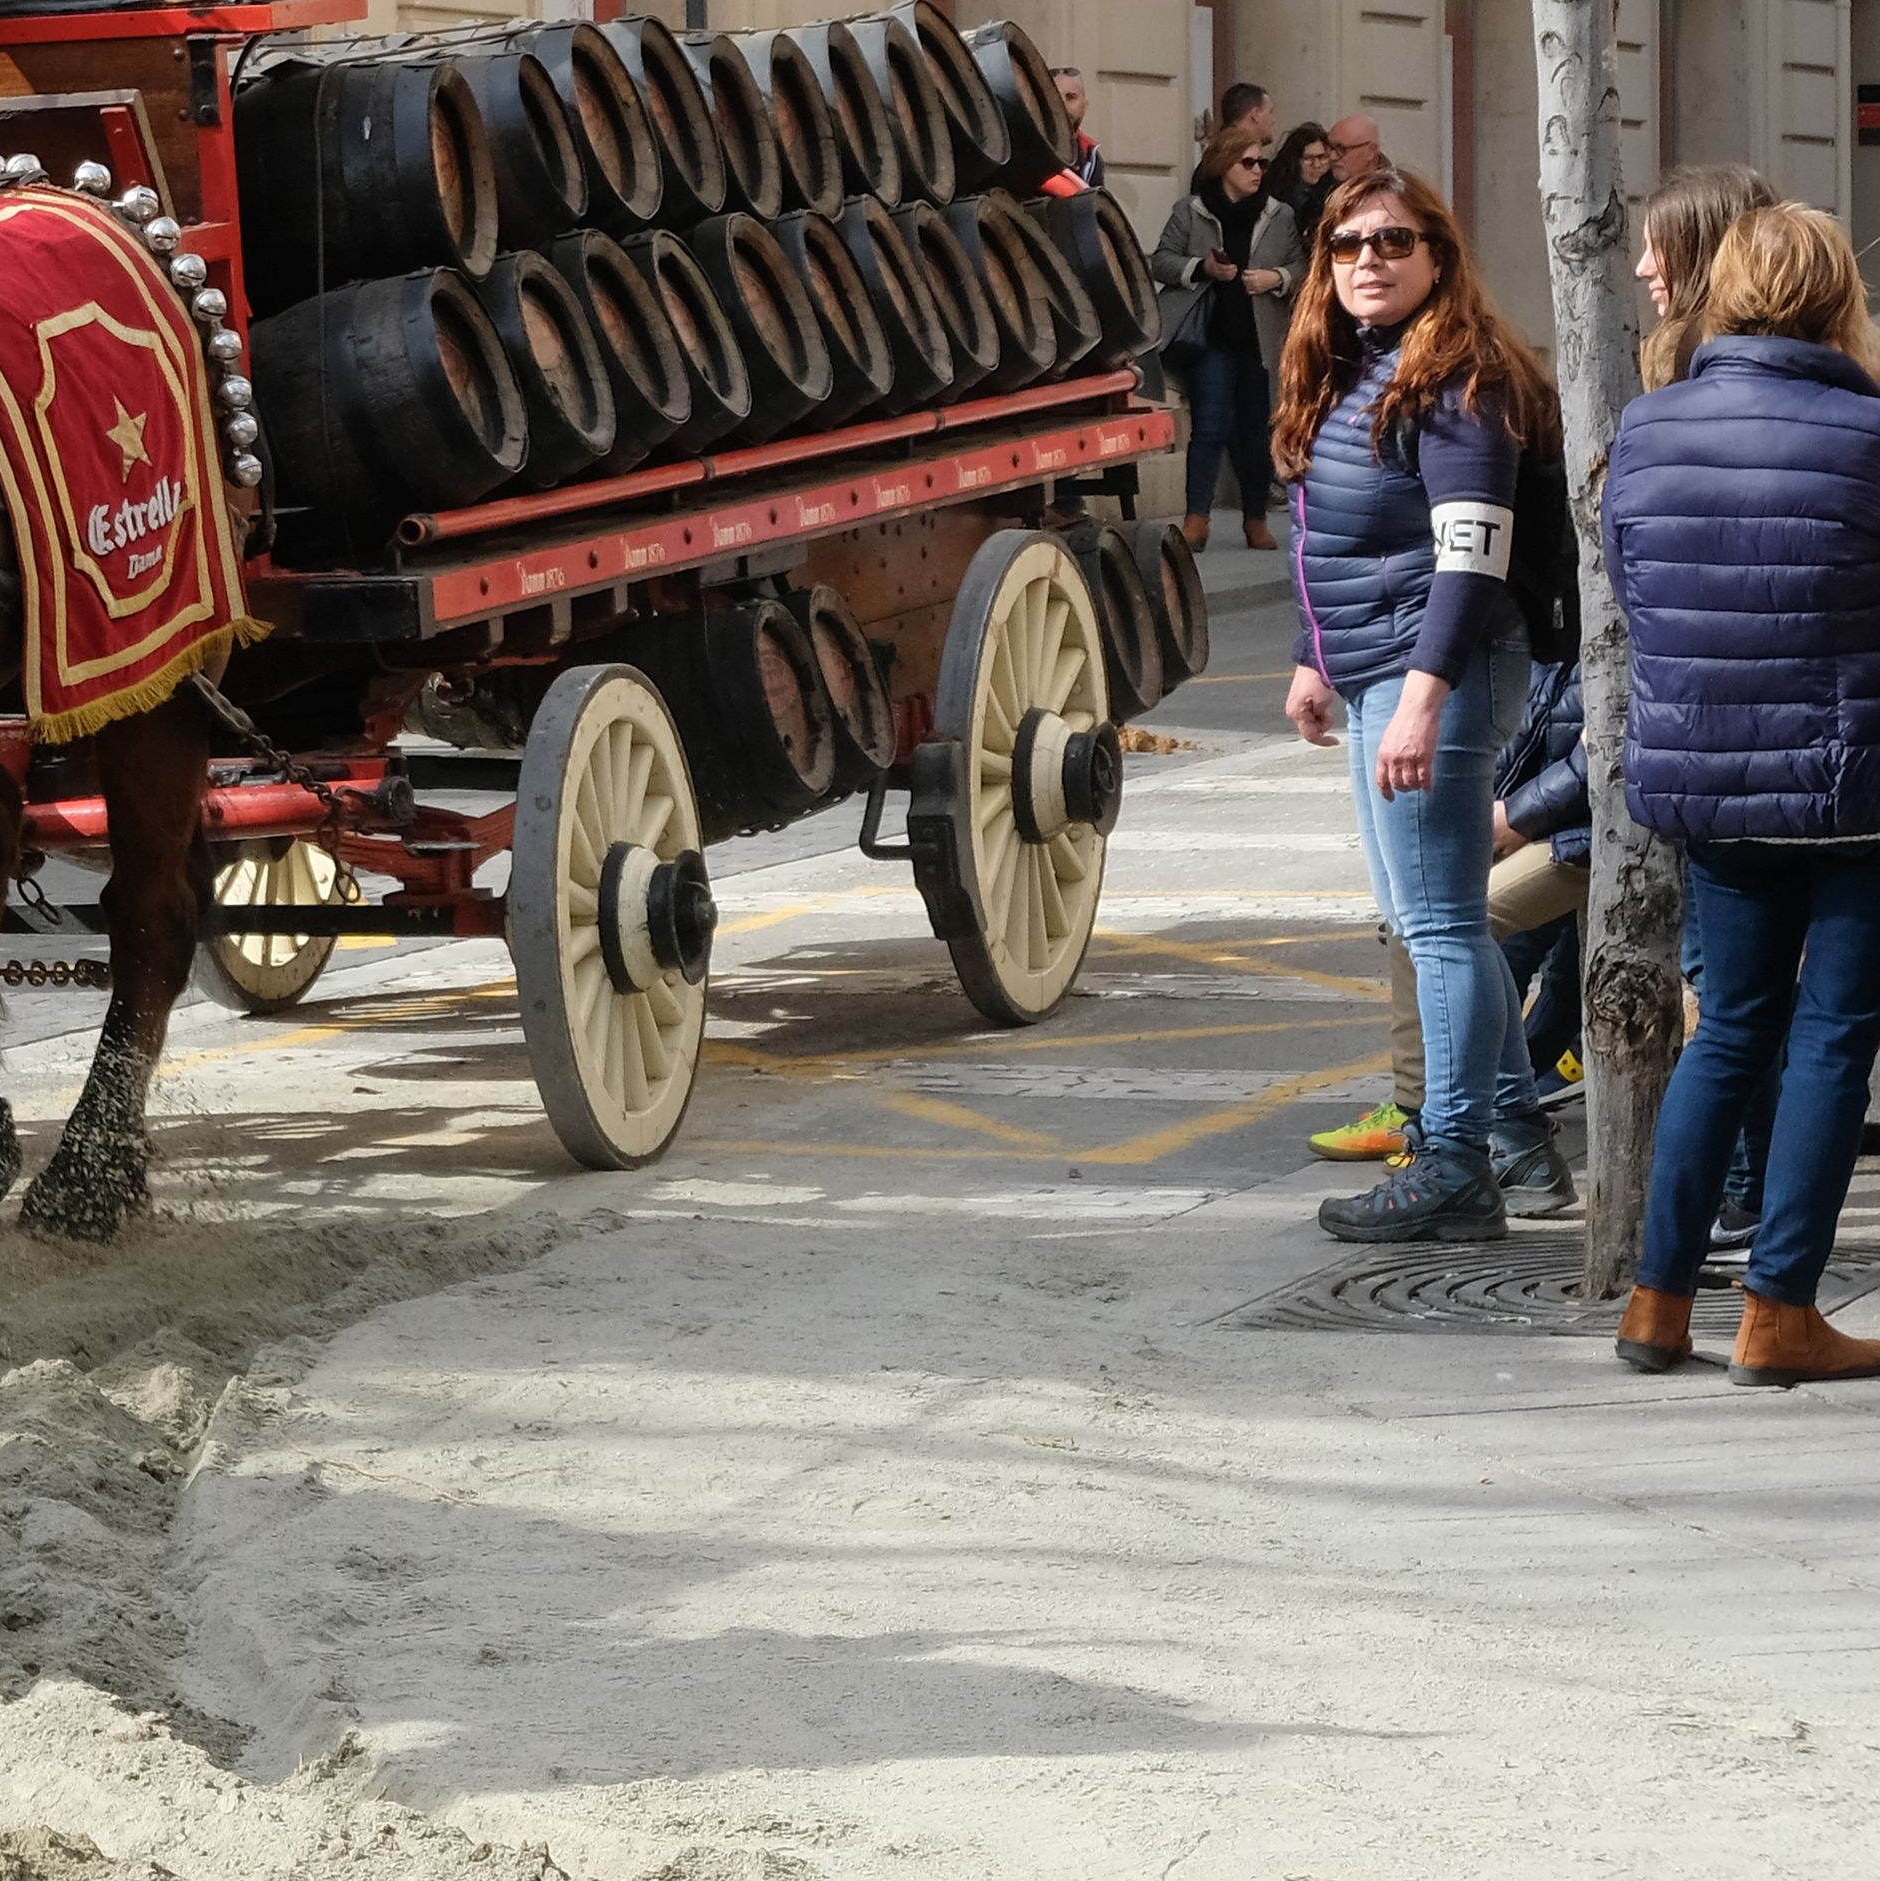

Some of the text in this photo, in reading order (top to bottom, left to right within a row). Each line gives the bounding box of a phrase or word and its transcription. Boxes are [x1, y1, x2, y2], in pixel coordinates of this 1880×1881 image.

[710, 516, 735, 548] Damm
[1435, 520, 1501, 556] VET
[620, 536, 665, 570] Damm 1876
[517, 561, 565, 595] Damm 1876
